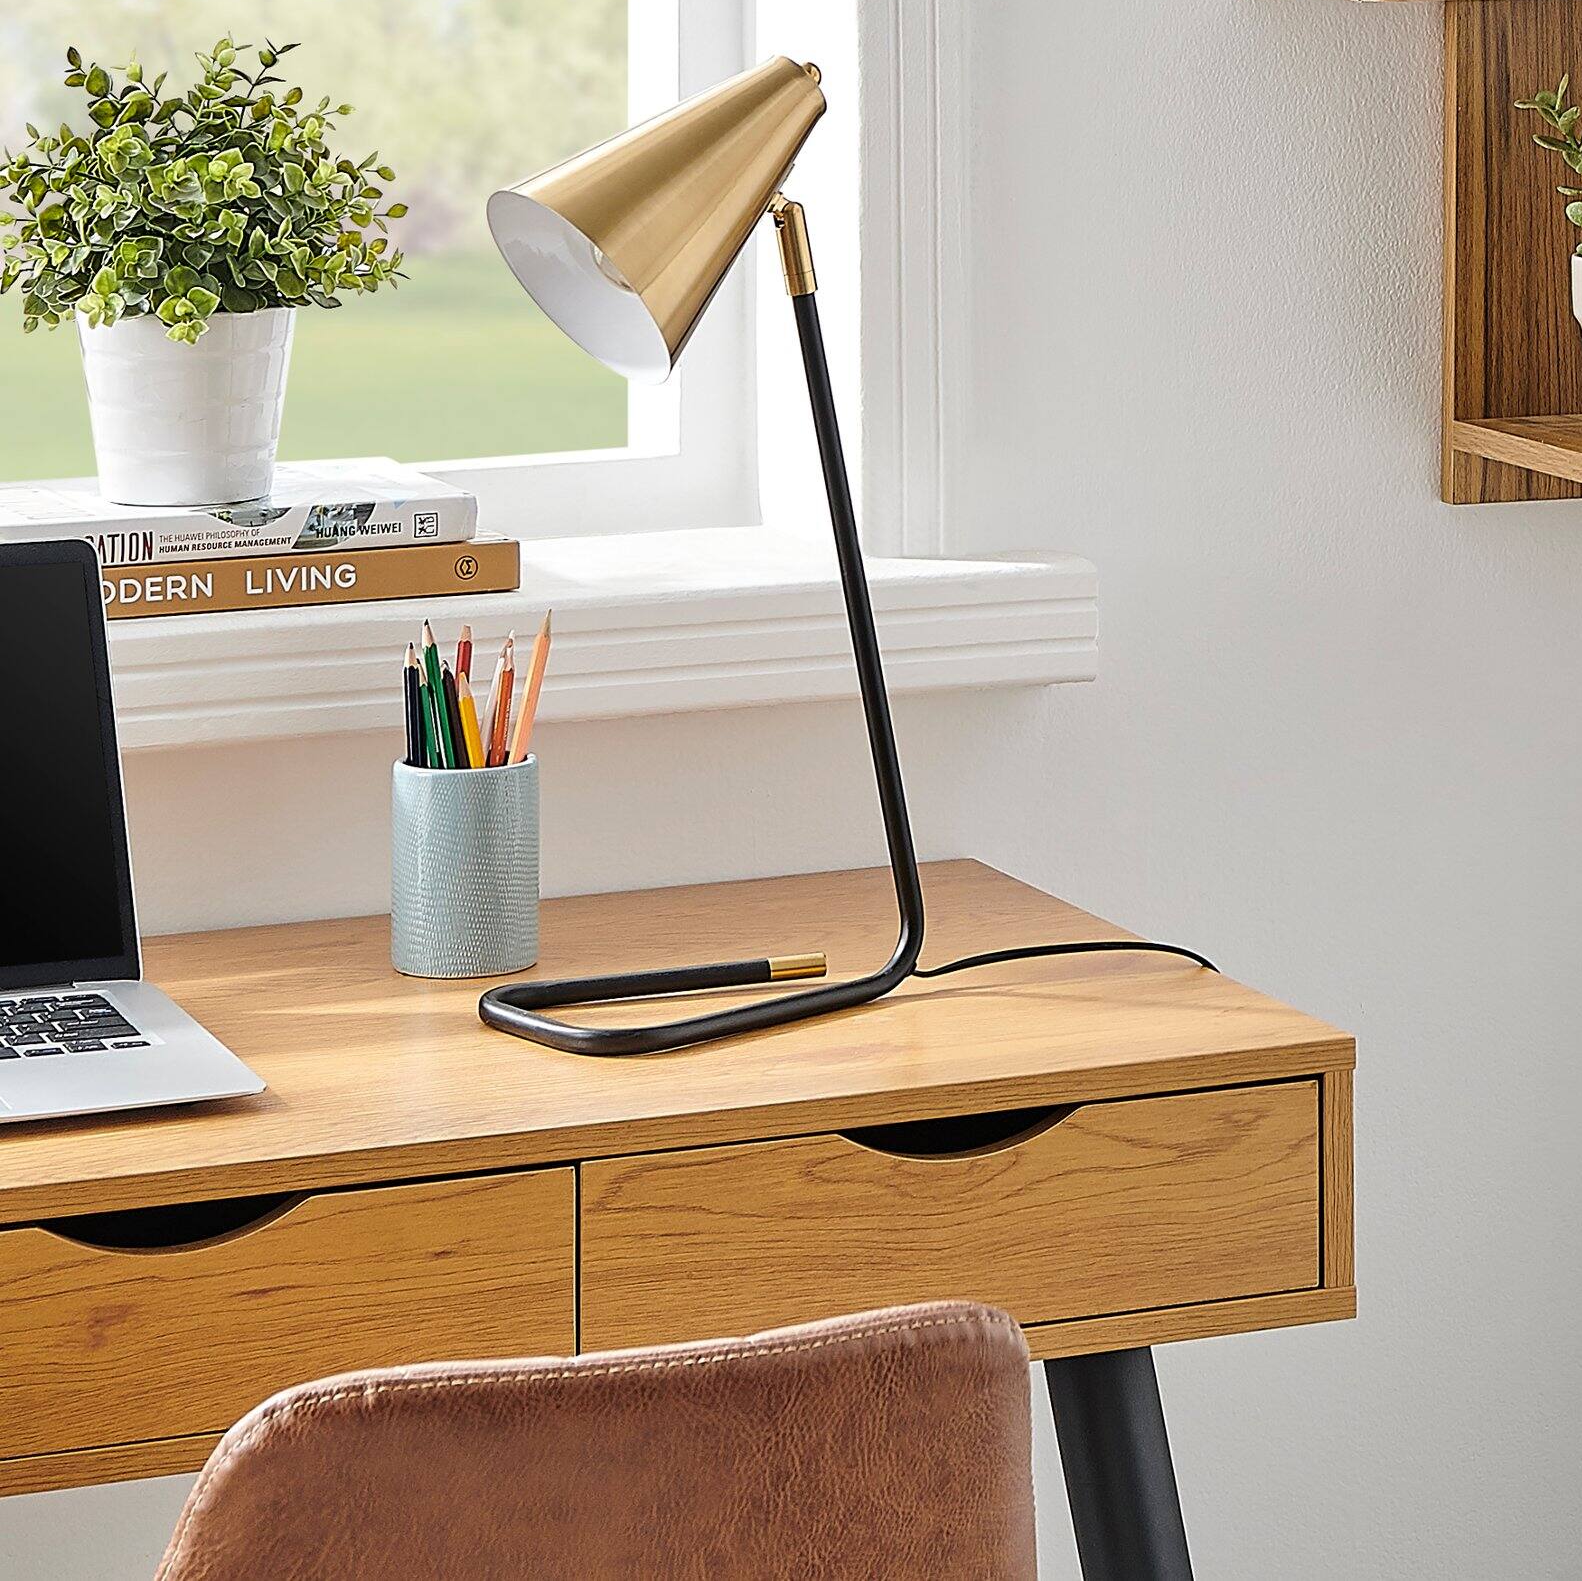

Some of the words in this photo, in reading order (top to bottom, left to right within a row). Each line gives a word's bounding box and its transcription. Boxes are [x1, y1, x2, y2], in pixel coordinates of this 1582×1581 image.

[159, 534, 172, 543] THE
[175, 532, 204, 542] HUAWEI
[206, 530, 249, 540] PHILOSOPHY
[251, 528, 261, 537] OF
[316, 525, 356, 539] HUANG
[358, 523, 402, 536] WEIWEI
[86, 531, 153, 564] ATION
[159, 544, 189, 553] HUMAN
[192, 541, 232, 551] RESOURCE
[234, 537, 291, 548] MANAGEMENT
[246, 564, 357, 596] LIVING
